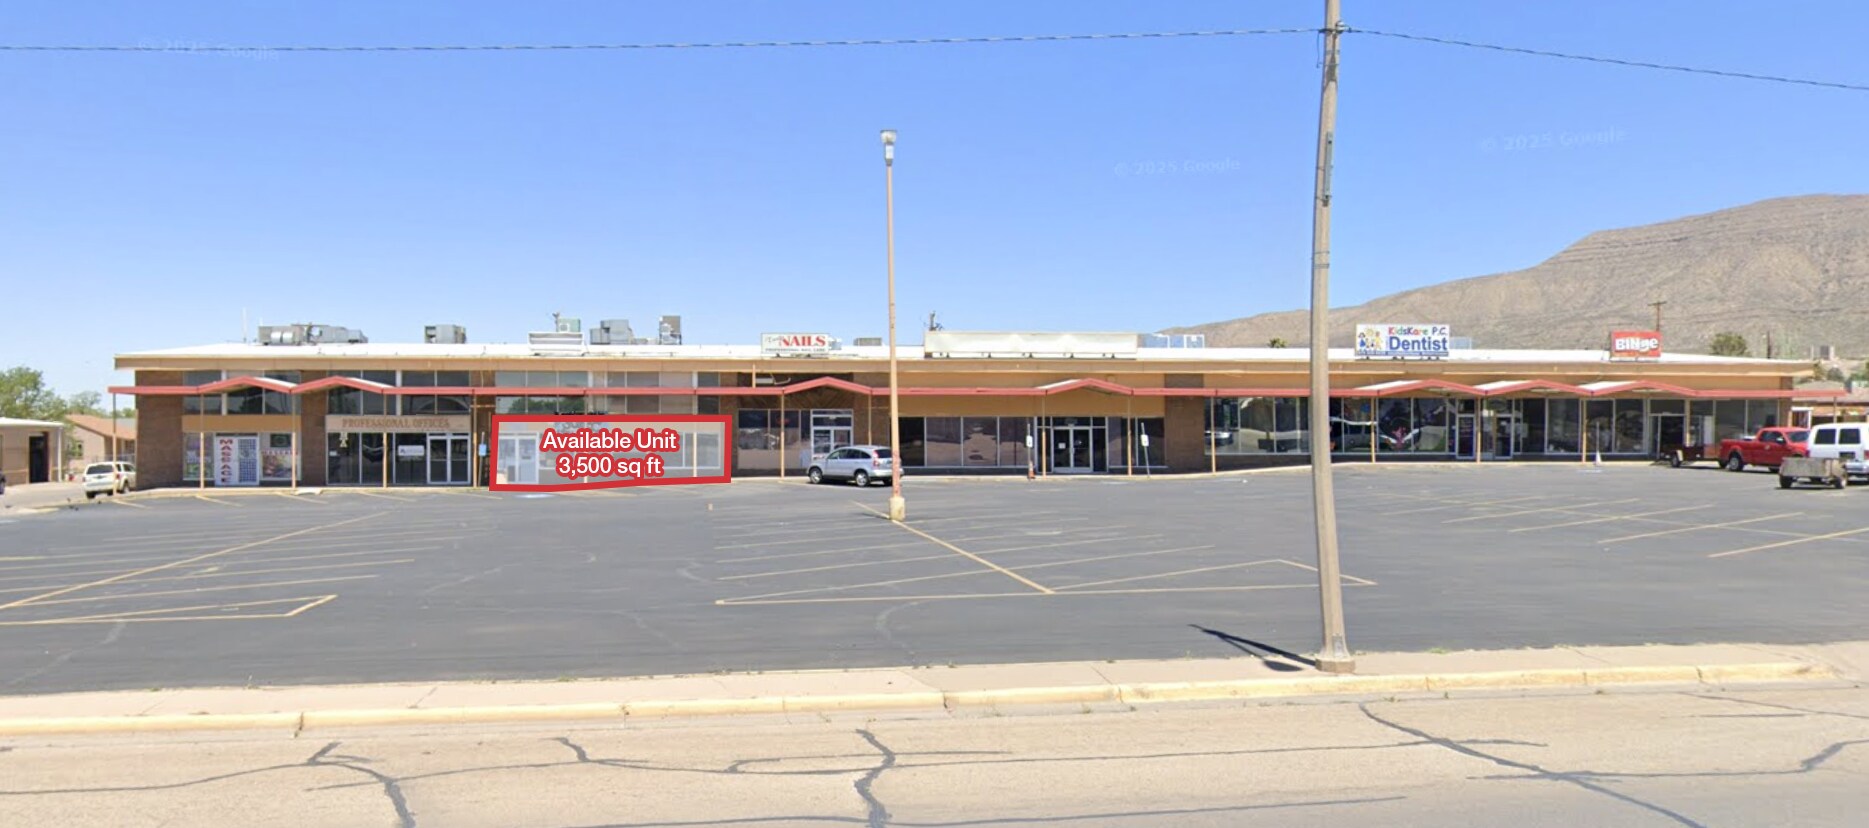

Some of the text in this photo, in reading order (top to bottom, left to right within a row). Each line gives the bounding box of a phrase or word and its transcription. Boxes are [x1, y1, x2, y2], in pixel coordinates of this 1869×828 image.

[1388, 326, 1429, 335] KidsKare
[780, 335, 826, 347] NAILS
[1389, 336, 1448, 351] Dentist
[342, 418, 450, 428] PROFESSIONAL OFFICES
[219, 439, 233, 483] MASSAGE
